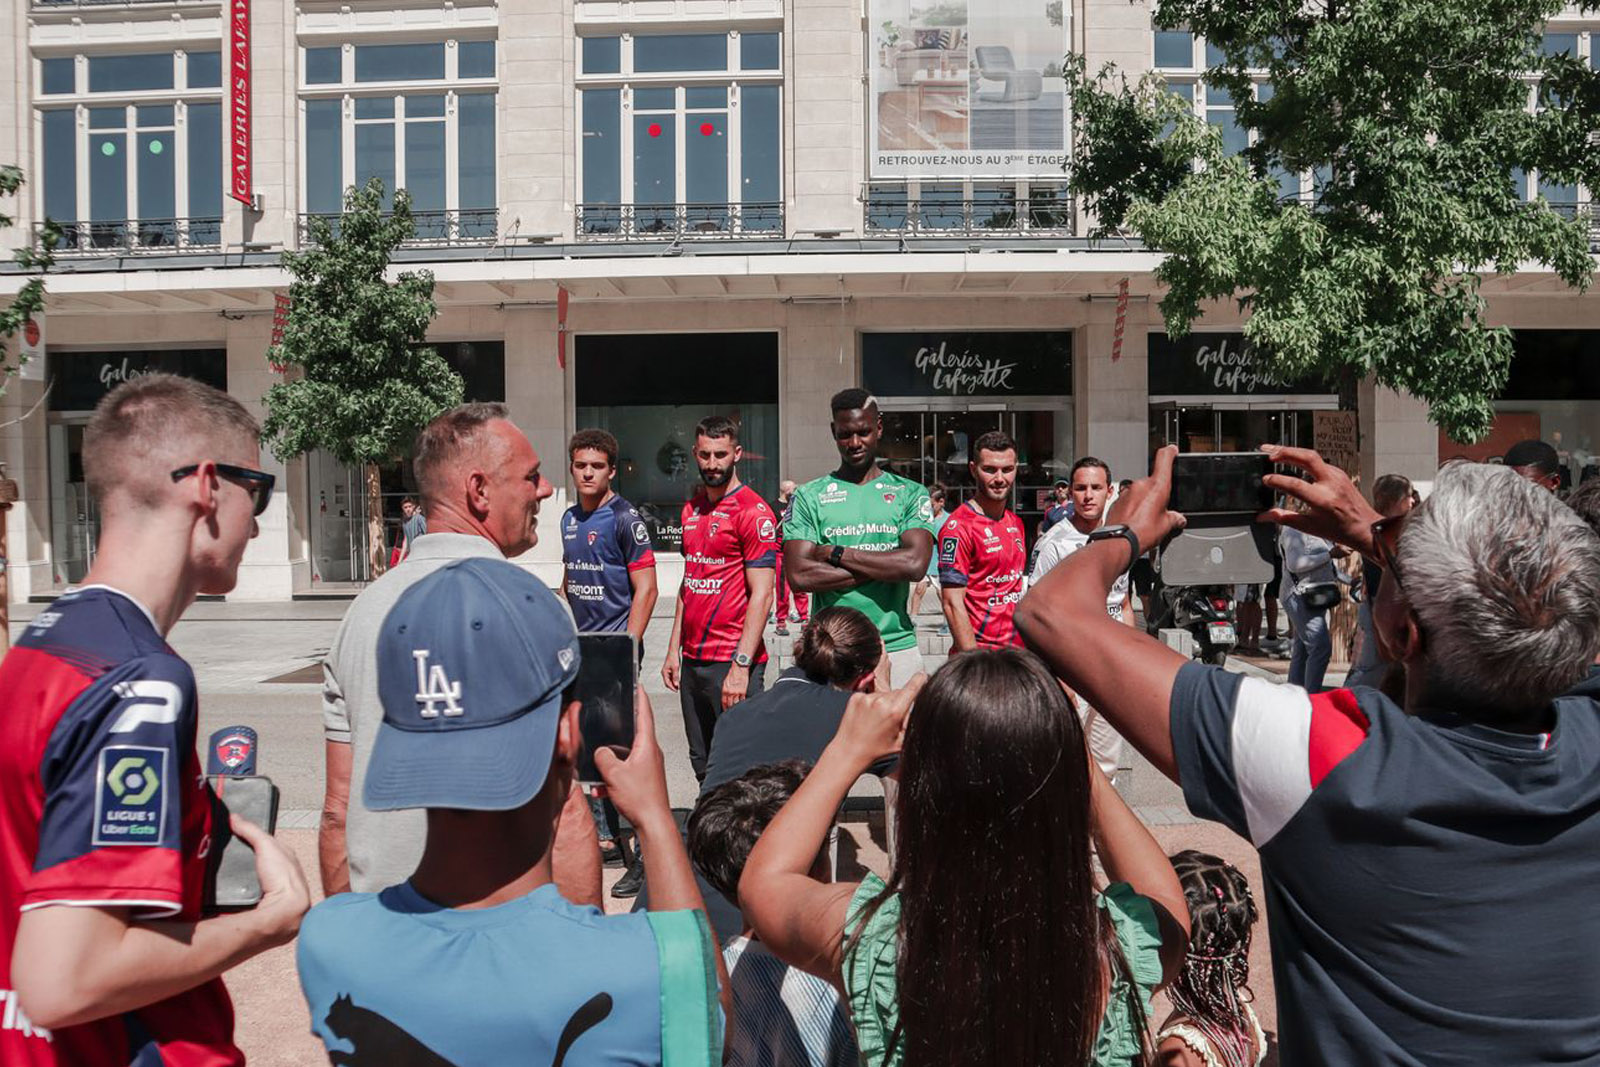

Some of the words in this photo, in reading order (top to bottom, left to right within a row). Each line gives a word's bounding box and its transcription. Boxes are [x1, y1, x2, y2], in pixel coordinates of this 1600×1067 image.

[235, 75, 247, 195] GALERIES
[878, 155, 983, 165] RETROUVEZ-NOUS
[985, 155, 1001, 165] AU
[915, 341, 983, 374] Galeries
[933, 359, 1018, 395] Lafayette
[656, 526, 666, 535] La
[824, 525, 857, 538] Crédit
[866, 523, 899, 535] Mutue
[412, 650, 464, 718] LA
[107, 810, 146, 821] LIGUE
[147, 811, 156, 821] 1
